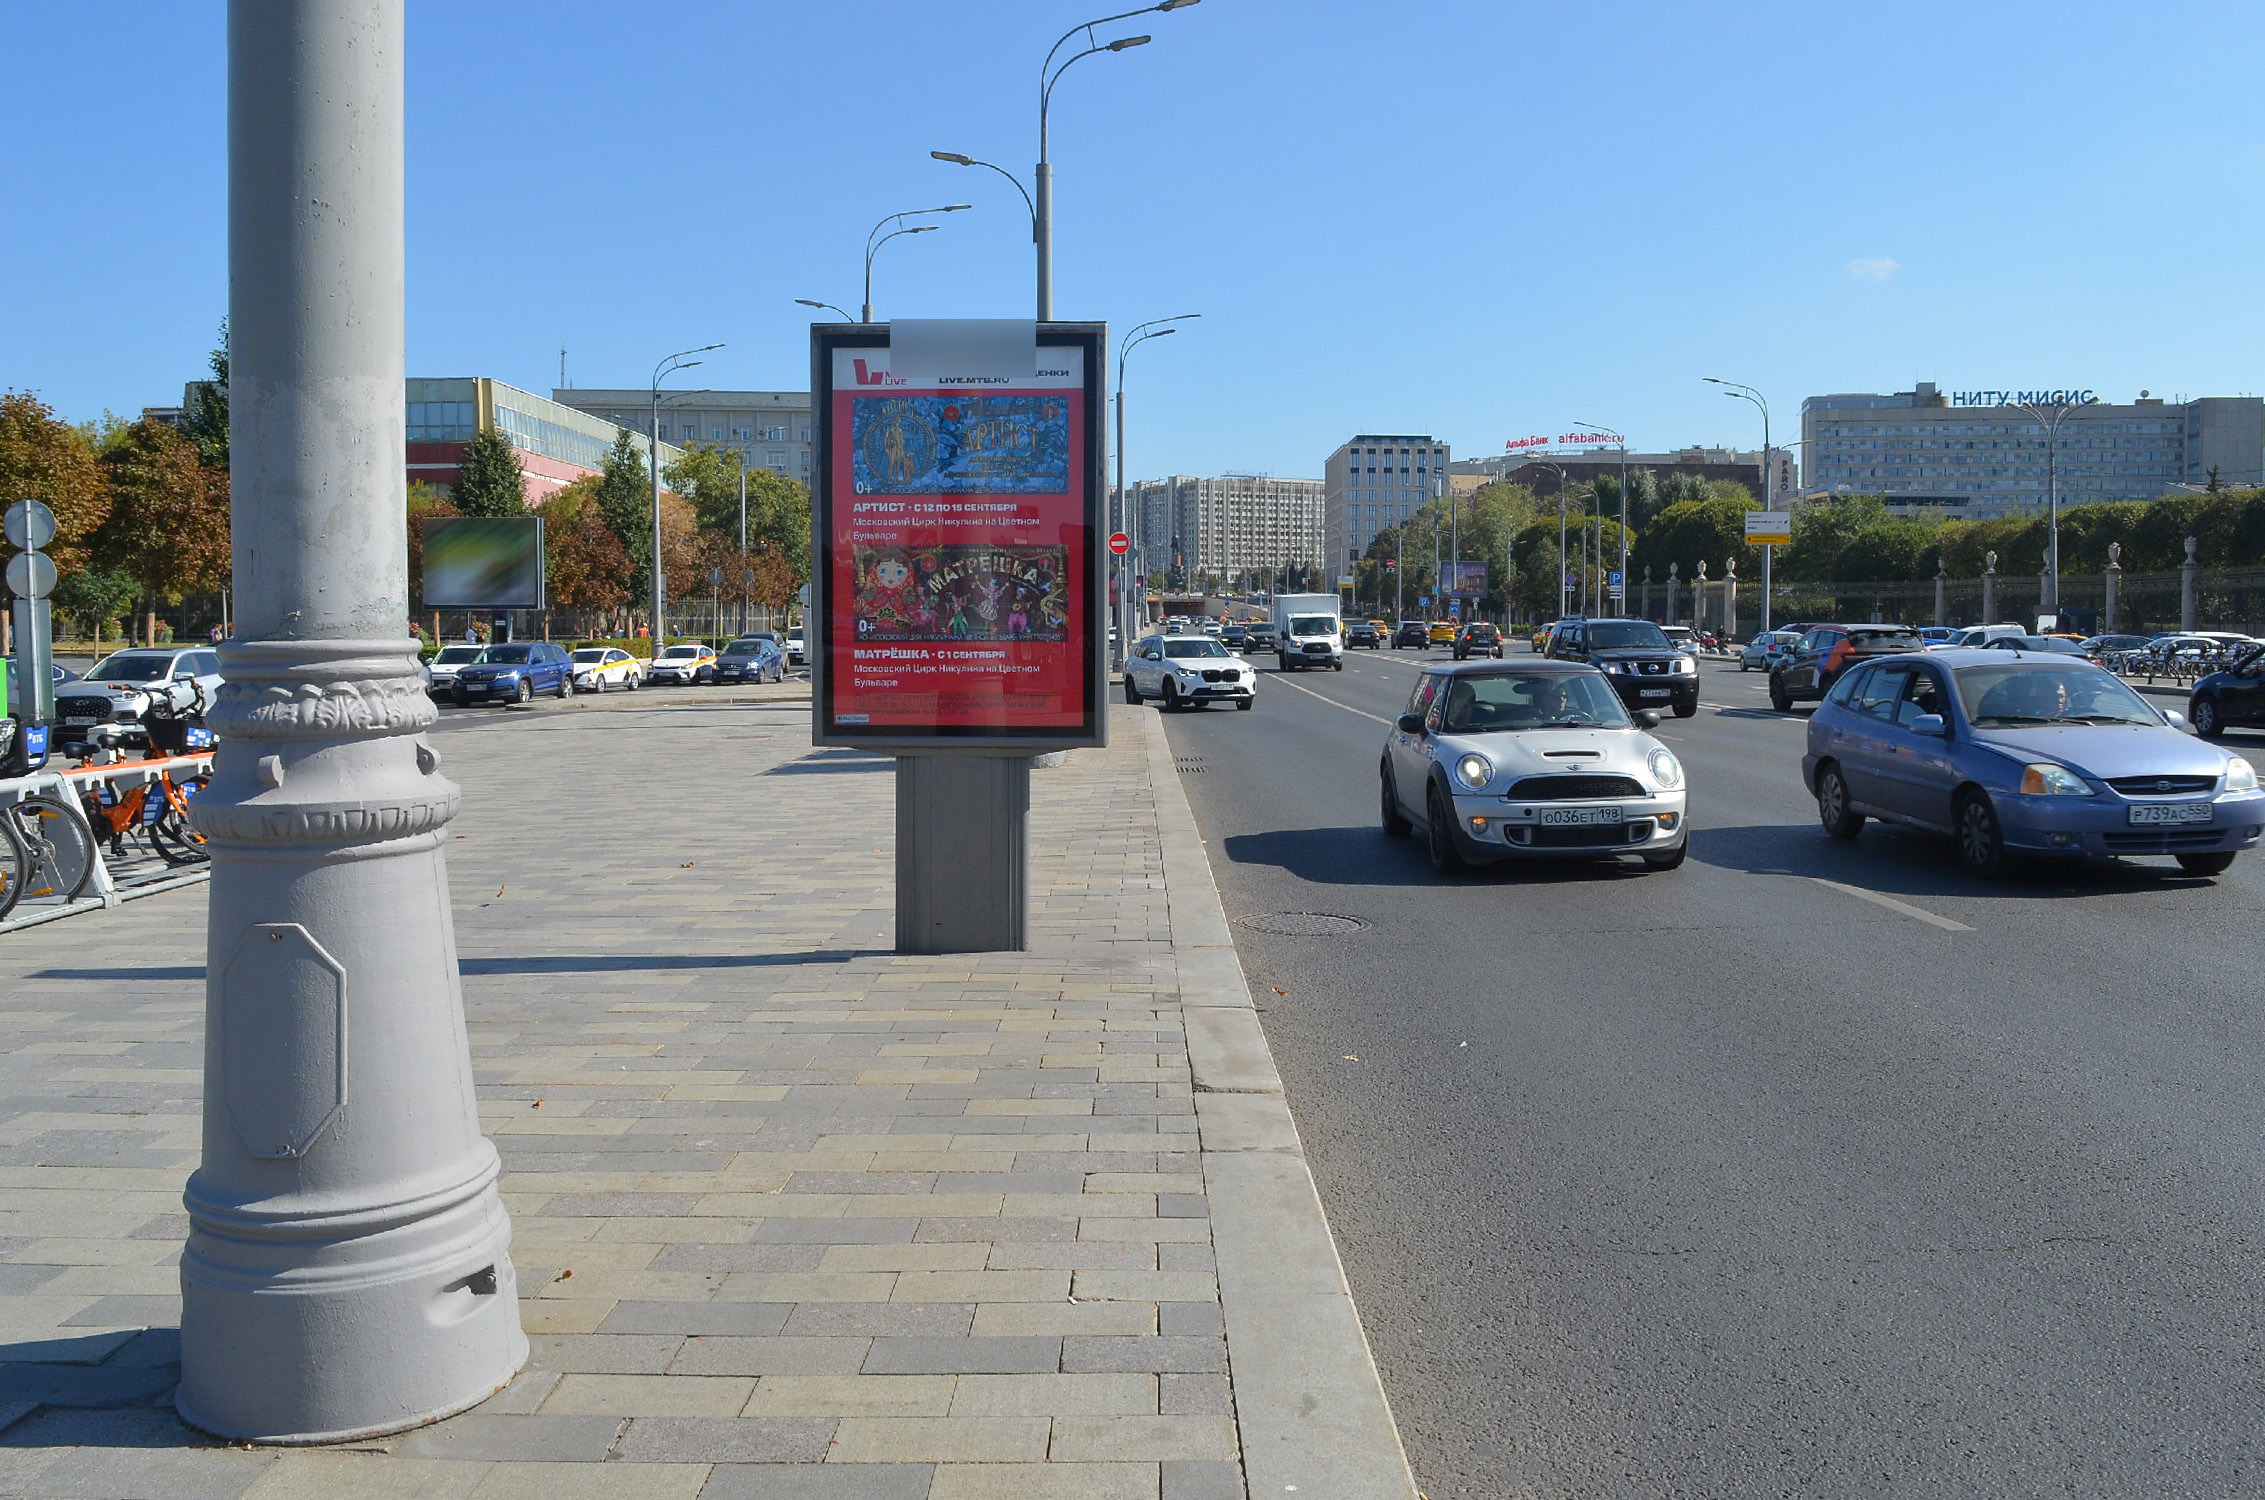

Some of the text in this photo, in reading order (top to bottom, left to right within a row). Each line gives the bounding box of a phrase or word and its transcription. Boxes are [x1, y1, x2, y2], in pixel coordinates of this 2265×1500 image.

[885, 378, 907, 386] LIVE
[1953, 390, 2093, 406] НИТУ МИСИС
[962, 420, 1040, 454] АРТИСТ
[1558, 432, 1625, 444] alfabank.ru
[1505, 438, 1529, 450] Альфа
[856, 480, 873, 494] 0+
[853, 503, 1017, 512] АРТИСТ С 12 ПО 15 СЕНТЯБРЯ
[853, 516, 910, 526] Московский
[912, 518, 936, 528] Цирк
[938, 518, 983, 528] Никулина
[998, 518, 1040, 527] Цветном
[853, 532, 897, 541] Бульваре
[927, 553, 1039, 594] МАТРЁШКА
[859, 619, 876, 632] 0+
[854, 646, 1006, 660] МАТРЁШКА С 1 СЕНТЯБРЯ
[854, 664, 911, 673] Московский
[913, 664, 937, 674] Цирк
[939, 664, 984, 674] Никулина
[999, 664, 1040, 674] Цветном
[854, 678, 898, 688] Бульваре
[1600, 808, 1618, 819] 198
